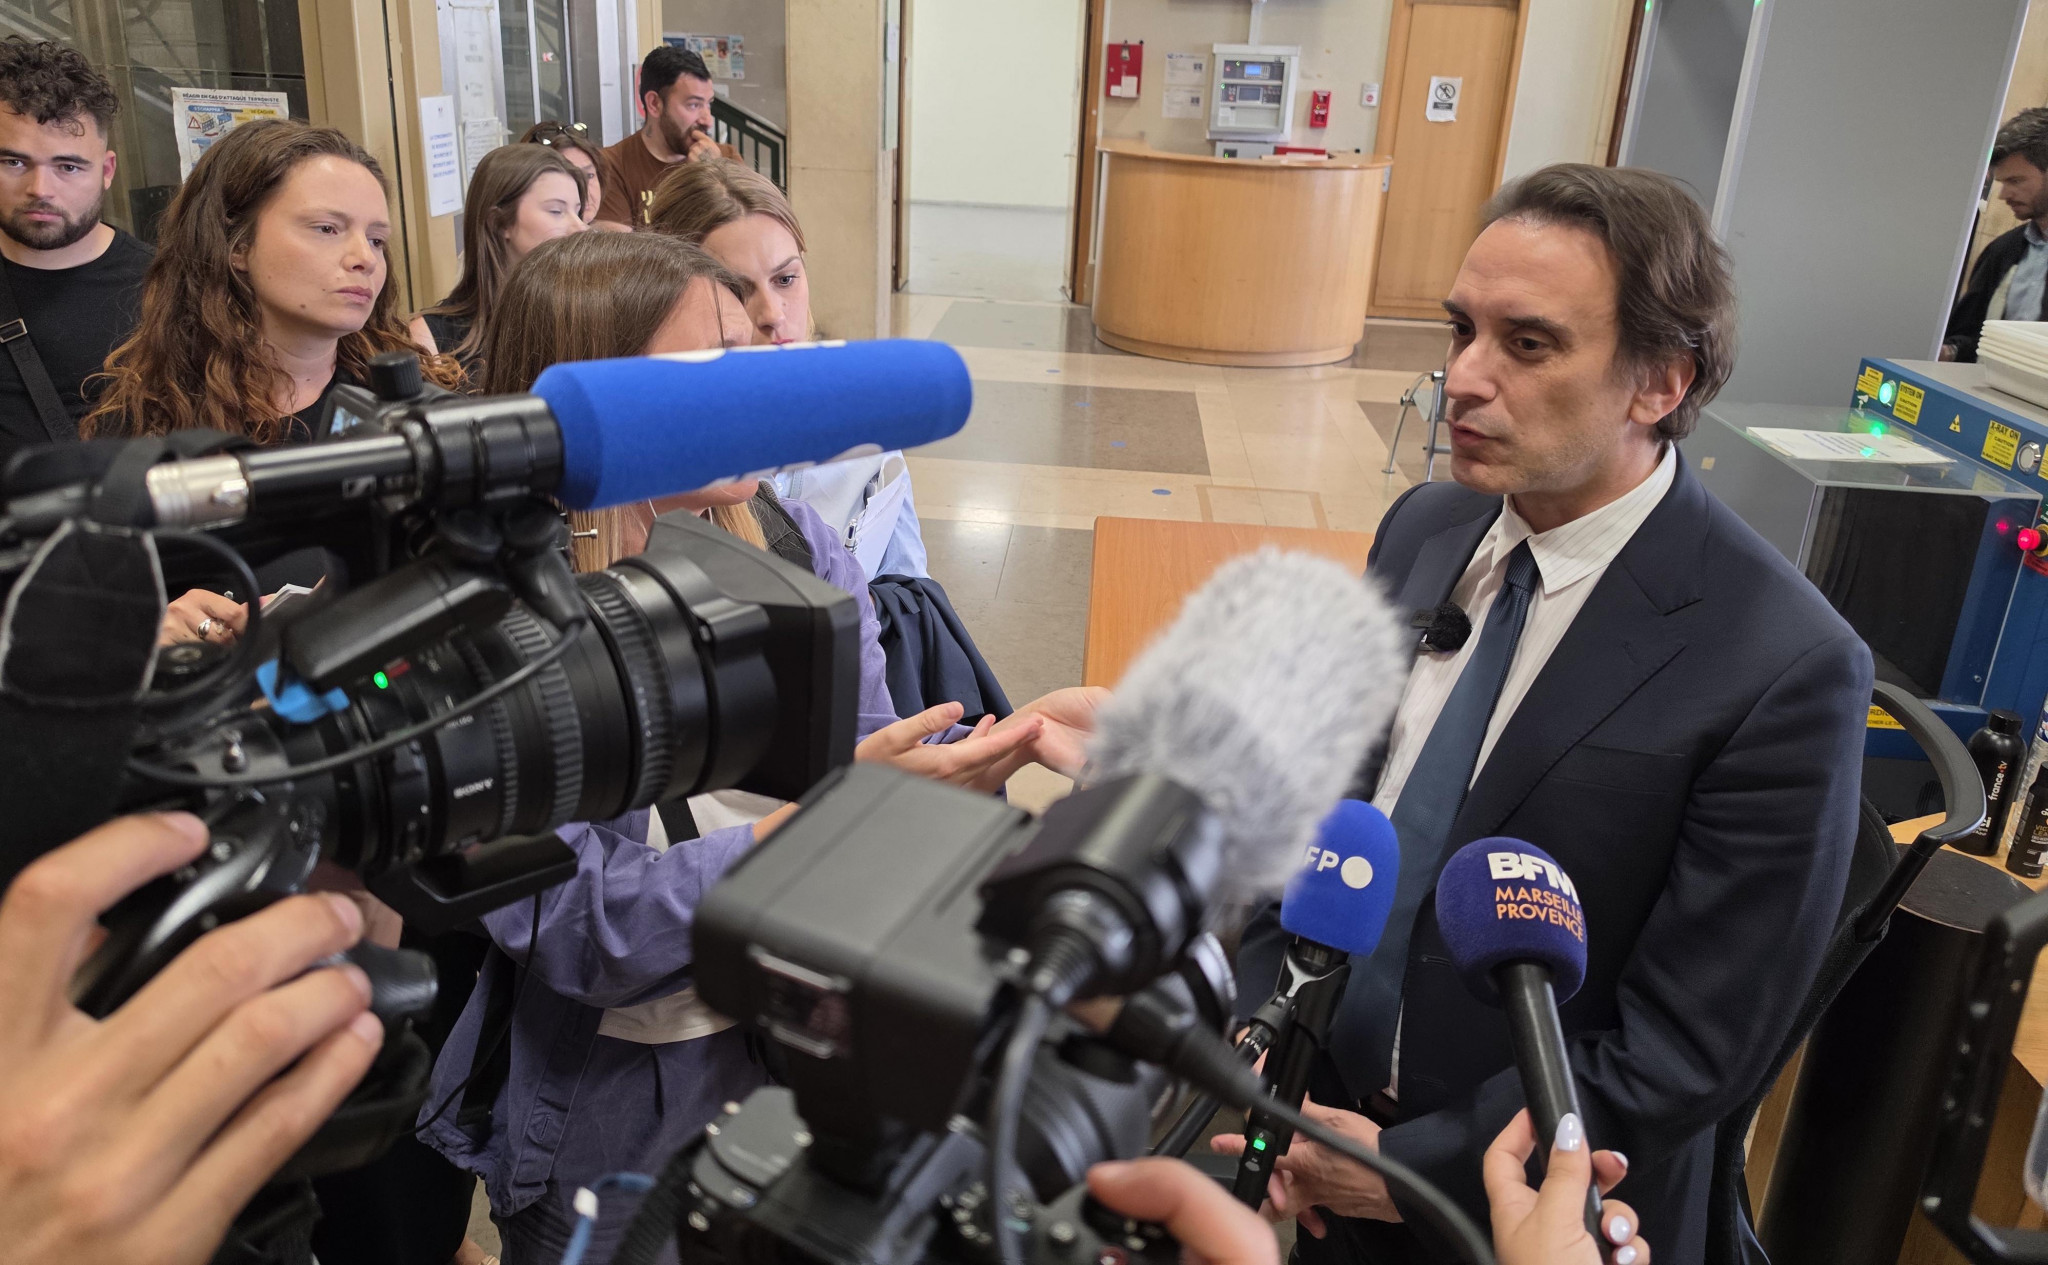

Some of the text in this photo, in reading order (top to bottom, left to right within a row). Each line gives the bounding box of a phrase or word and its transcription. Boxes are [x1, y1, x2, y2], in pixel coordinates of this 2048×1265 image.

[1990, 422, 2020, 440] X-RAY ON
[1994, 436, 2015, 448] CAUTION
[1304, 846, 1340, 872] FP
[1487, 852, 1580, 905] BFM
[1495, 885, 1583, 927] MARSEILLE
[1496, 903, 1584, 943] PROVENCE
